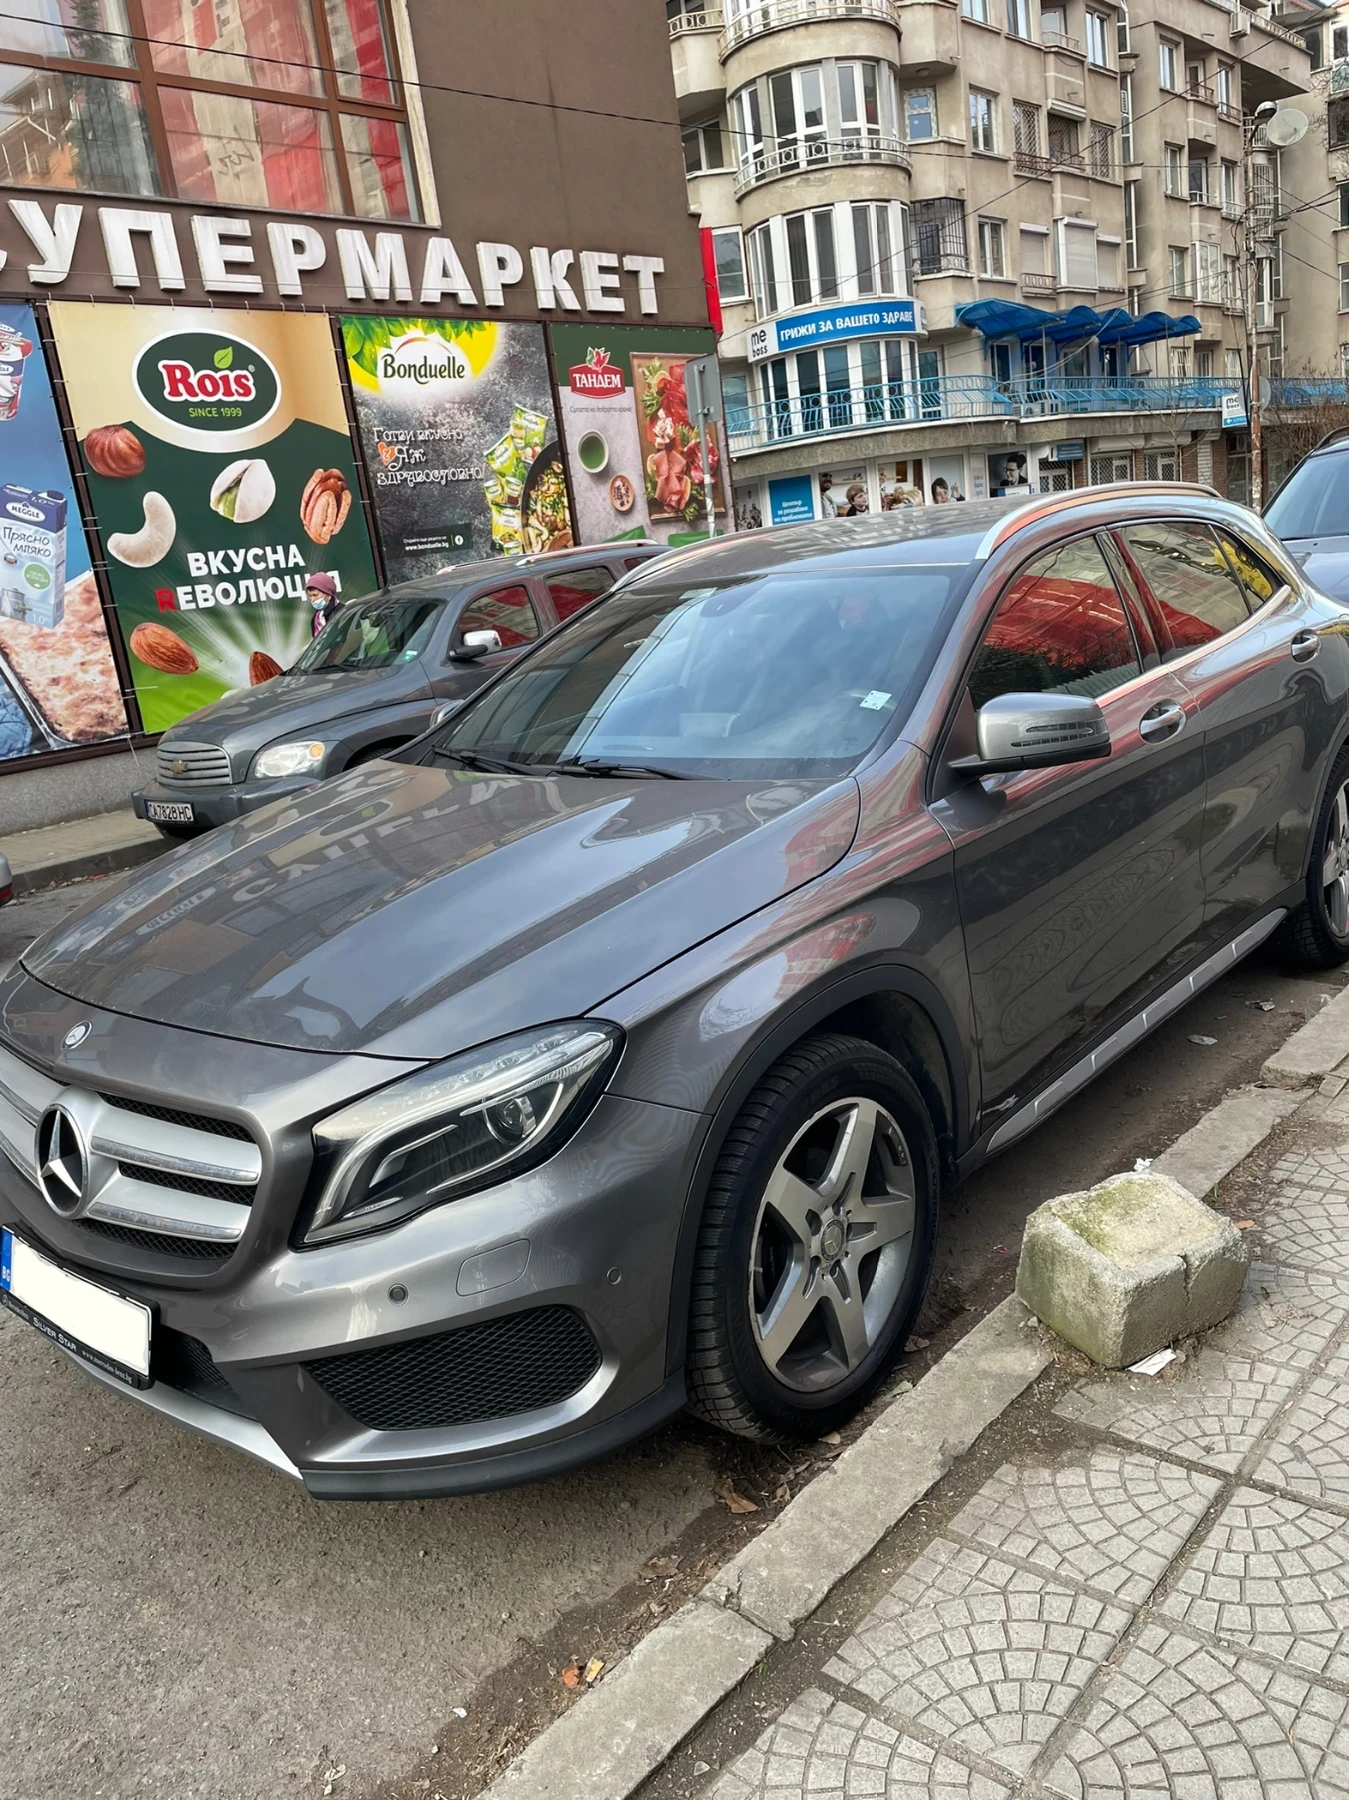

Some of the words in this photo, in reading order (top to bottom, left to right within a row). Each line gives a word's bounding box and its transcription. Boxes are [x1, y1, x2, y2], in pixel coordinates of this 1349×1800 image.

[0, 199, 665, 315] УПЕРМАРКЕТ
[751, 329, 767, 346] me
[780, 323, 817, 342] ГРИЖИ
[818, 321, 834, 333] ЗА
[836, 313, 880, 330] ВАШЕТО
[882, 311, 913, 324] ЗДРАВЕ
[160, 362, 254, 399] Rois
[380, 353, 465, 385] Bonduelle
[572, 373, 622, 389] ТАНДЕМ
[188, 407, 219, 418] SINCE
[220, 407, 242, 417] 1999
[11, 505, 40, 519] MEGGLE
[186, 543, 306, 578] ВКУСНА
[154, 569, 342, 614] RЕВОЛЮЦЯ
[33, 1316, 57, 1340] SILVER
[58, 1333, 77, 1352] STAR
